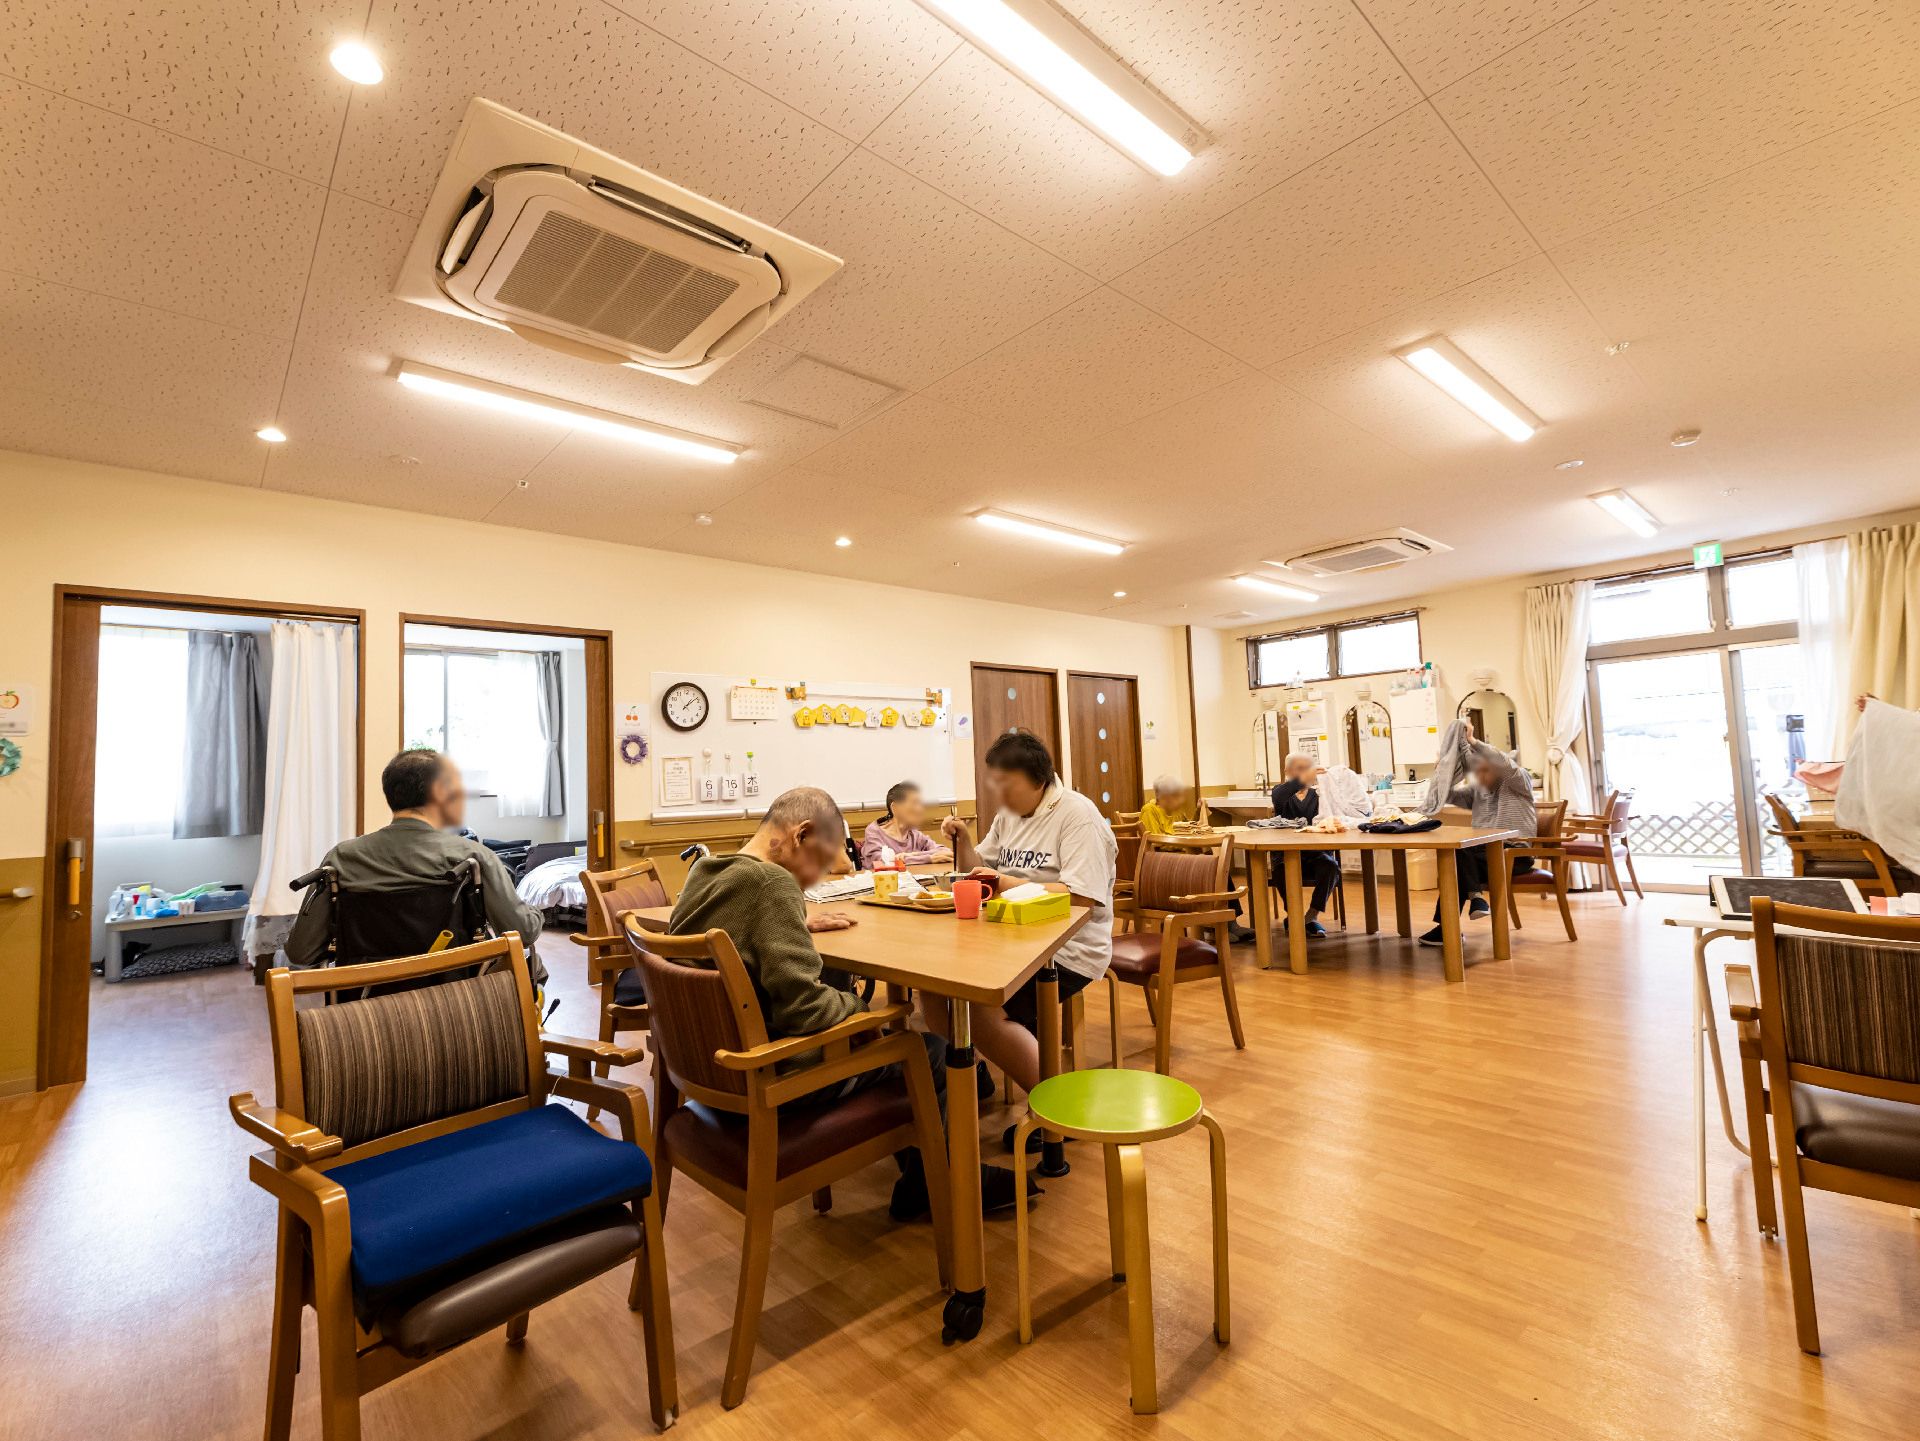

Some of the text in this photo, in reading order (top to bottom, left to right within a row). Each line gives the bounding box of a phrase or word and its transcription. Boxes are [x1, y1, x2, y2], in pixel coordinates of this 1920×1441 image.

[705, 779, 713, 790] 6
[725, 779, 738, 789] 16
[747, 776, 758, 785] 木
